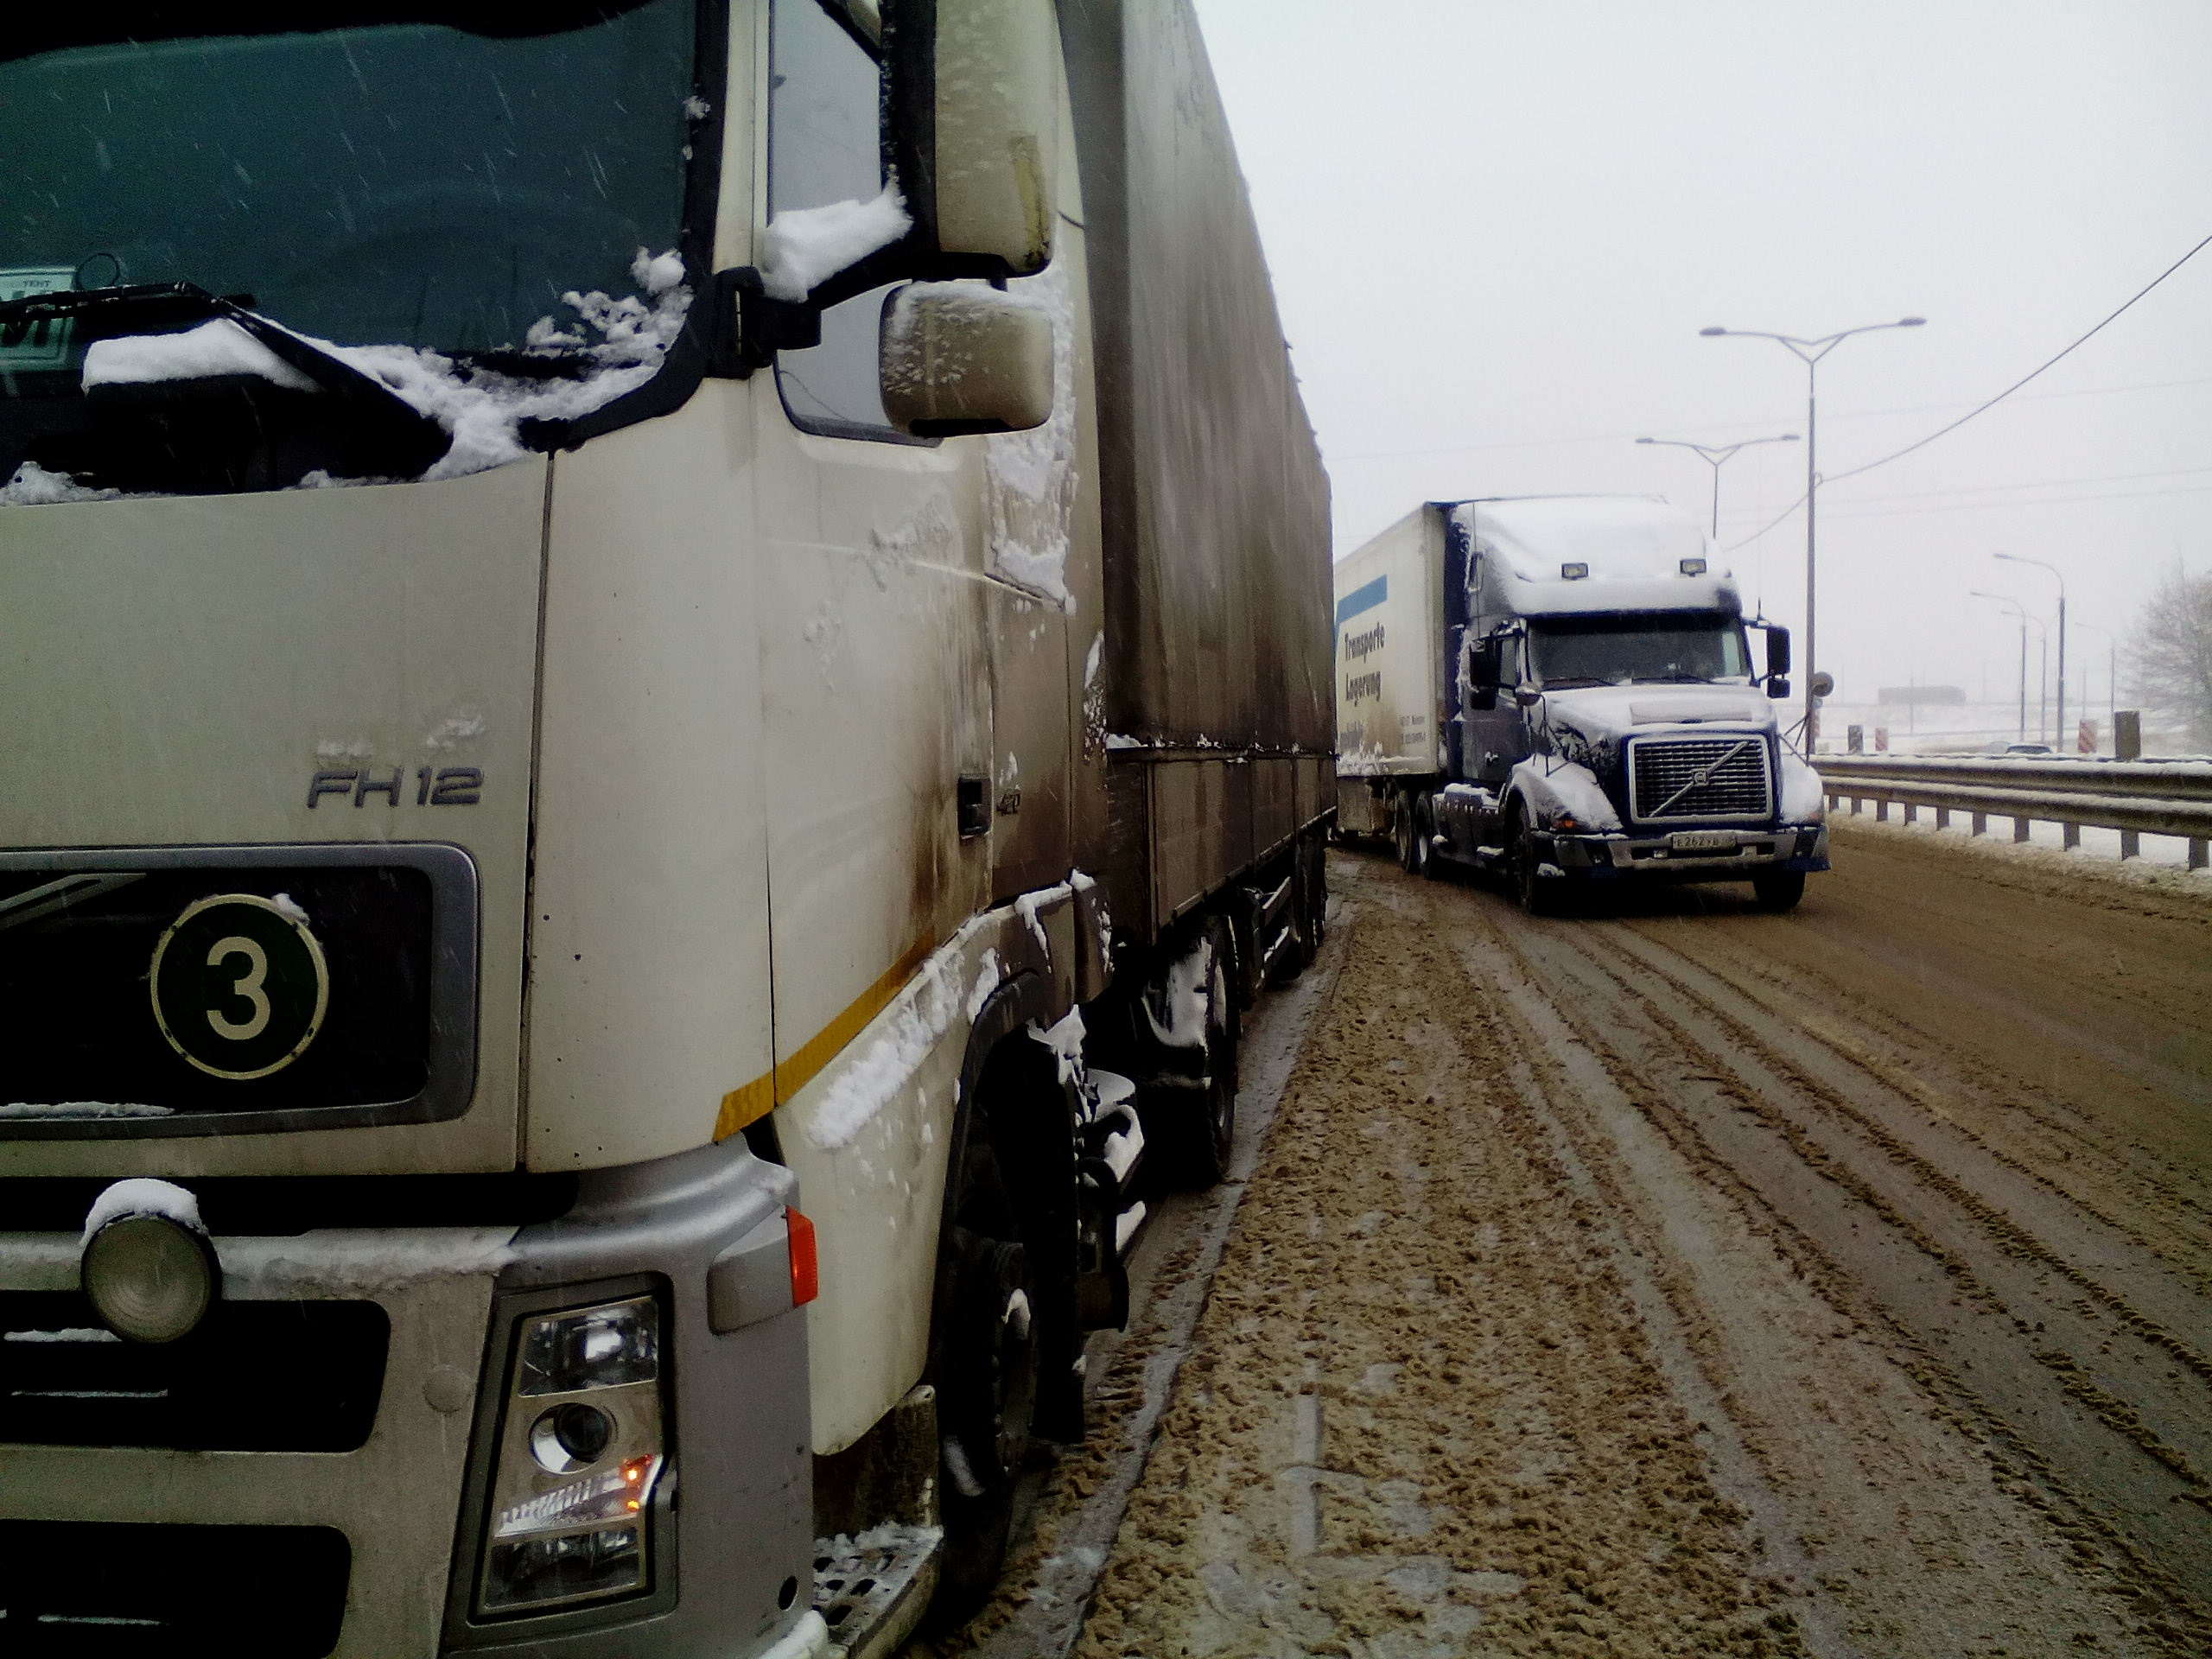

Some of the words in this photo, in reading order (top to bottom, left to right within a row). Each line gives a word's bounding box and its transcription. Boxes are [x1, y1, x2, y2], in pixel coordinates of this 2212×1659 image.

[1344, 620, 1385, 663] Transporte
[1345, 671, 1381, 706] Lagerung
[205, 936, 272, 1041] 3
